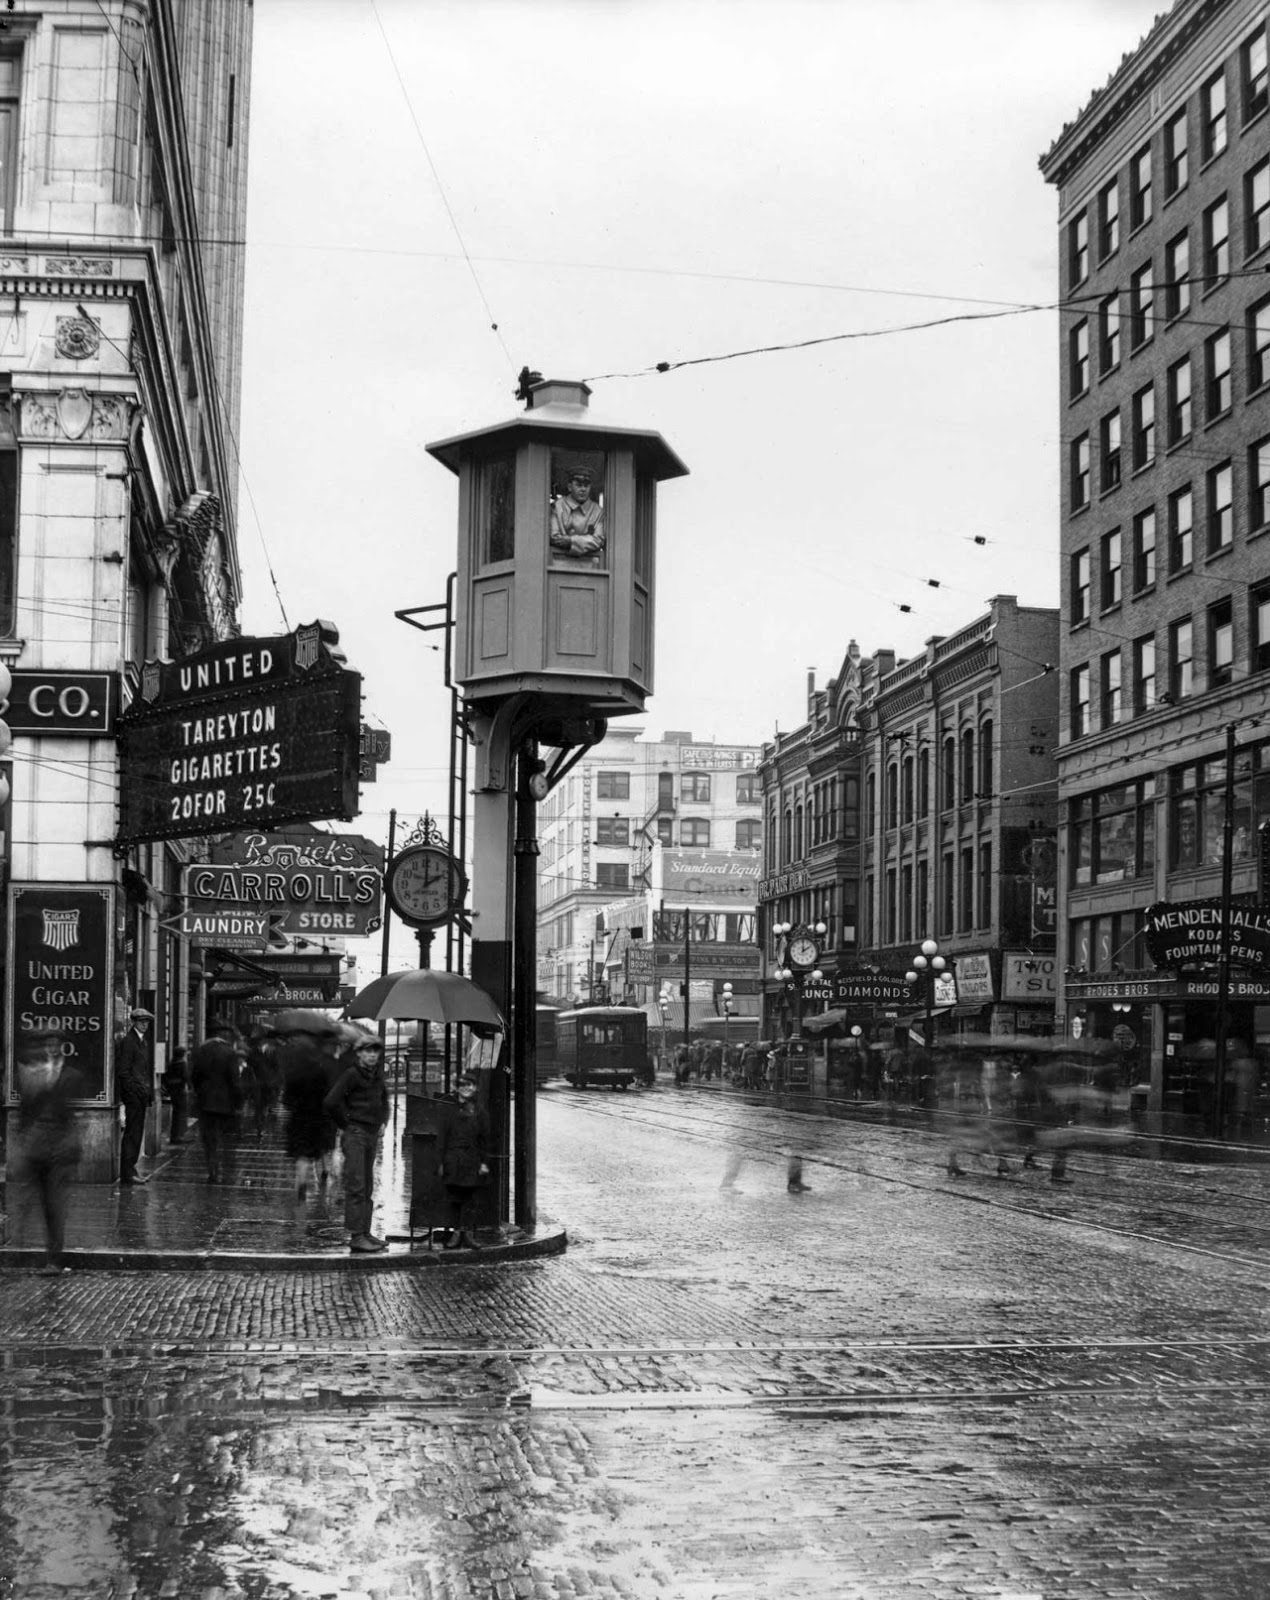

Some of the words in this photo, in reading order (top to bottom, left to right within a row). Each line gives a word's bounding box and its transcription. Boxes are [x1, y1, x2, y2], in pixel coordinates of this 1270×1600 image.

[180, 650, 273, 692] UNITED
[28, 684, 100, 718] CO.
[182, 705, 276, 746] TAREYTON
[671, 861, 727, 875] Standard
[195, 871, 375, 903] CARROLL'S
[45, 912, 78, 921] CIGARS
[300, 912, 356, 928] STORE
[1154, 908, 1270, 933] MENDENALL'S
[182, 917, 266, 934] LAUNDRY
[1188, 929, 1242, 941] KODAS
[1230, 945, 1263, 962] PENS
[28, 961, 94, 980] UNITED
[32, 987, 90, 1005] CIGAR
[839, 986, 911, 998] DIAMONDS
[1124, 984, 1149, 995] BROS
[1187, 982, 1234, 995] RHODS
[21, 1012, 100, 1031] STORES
